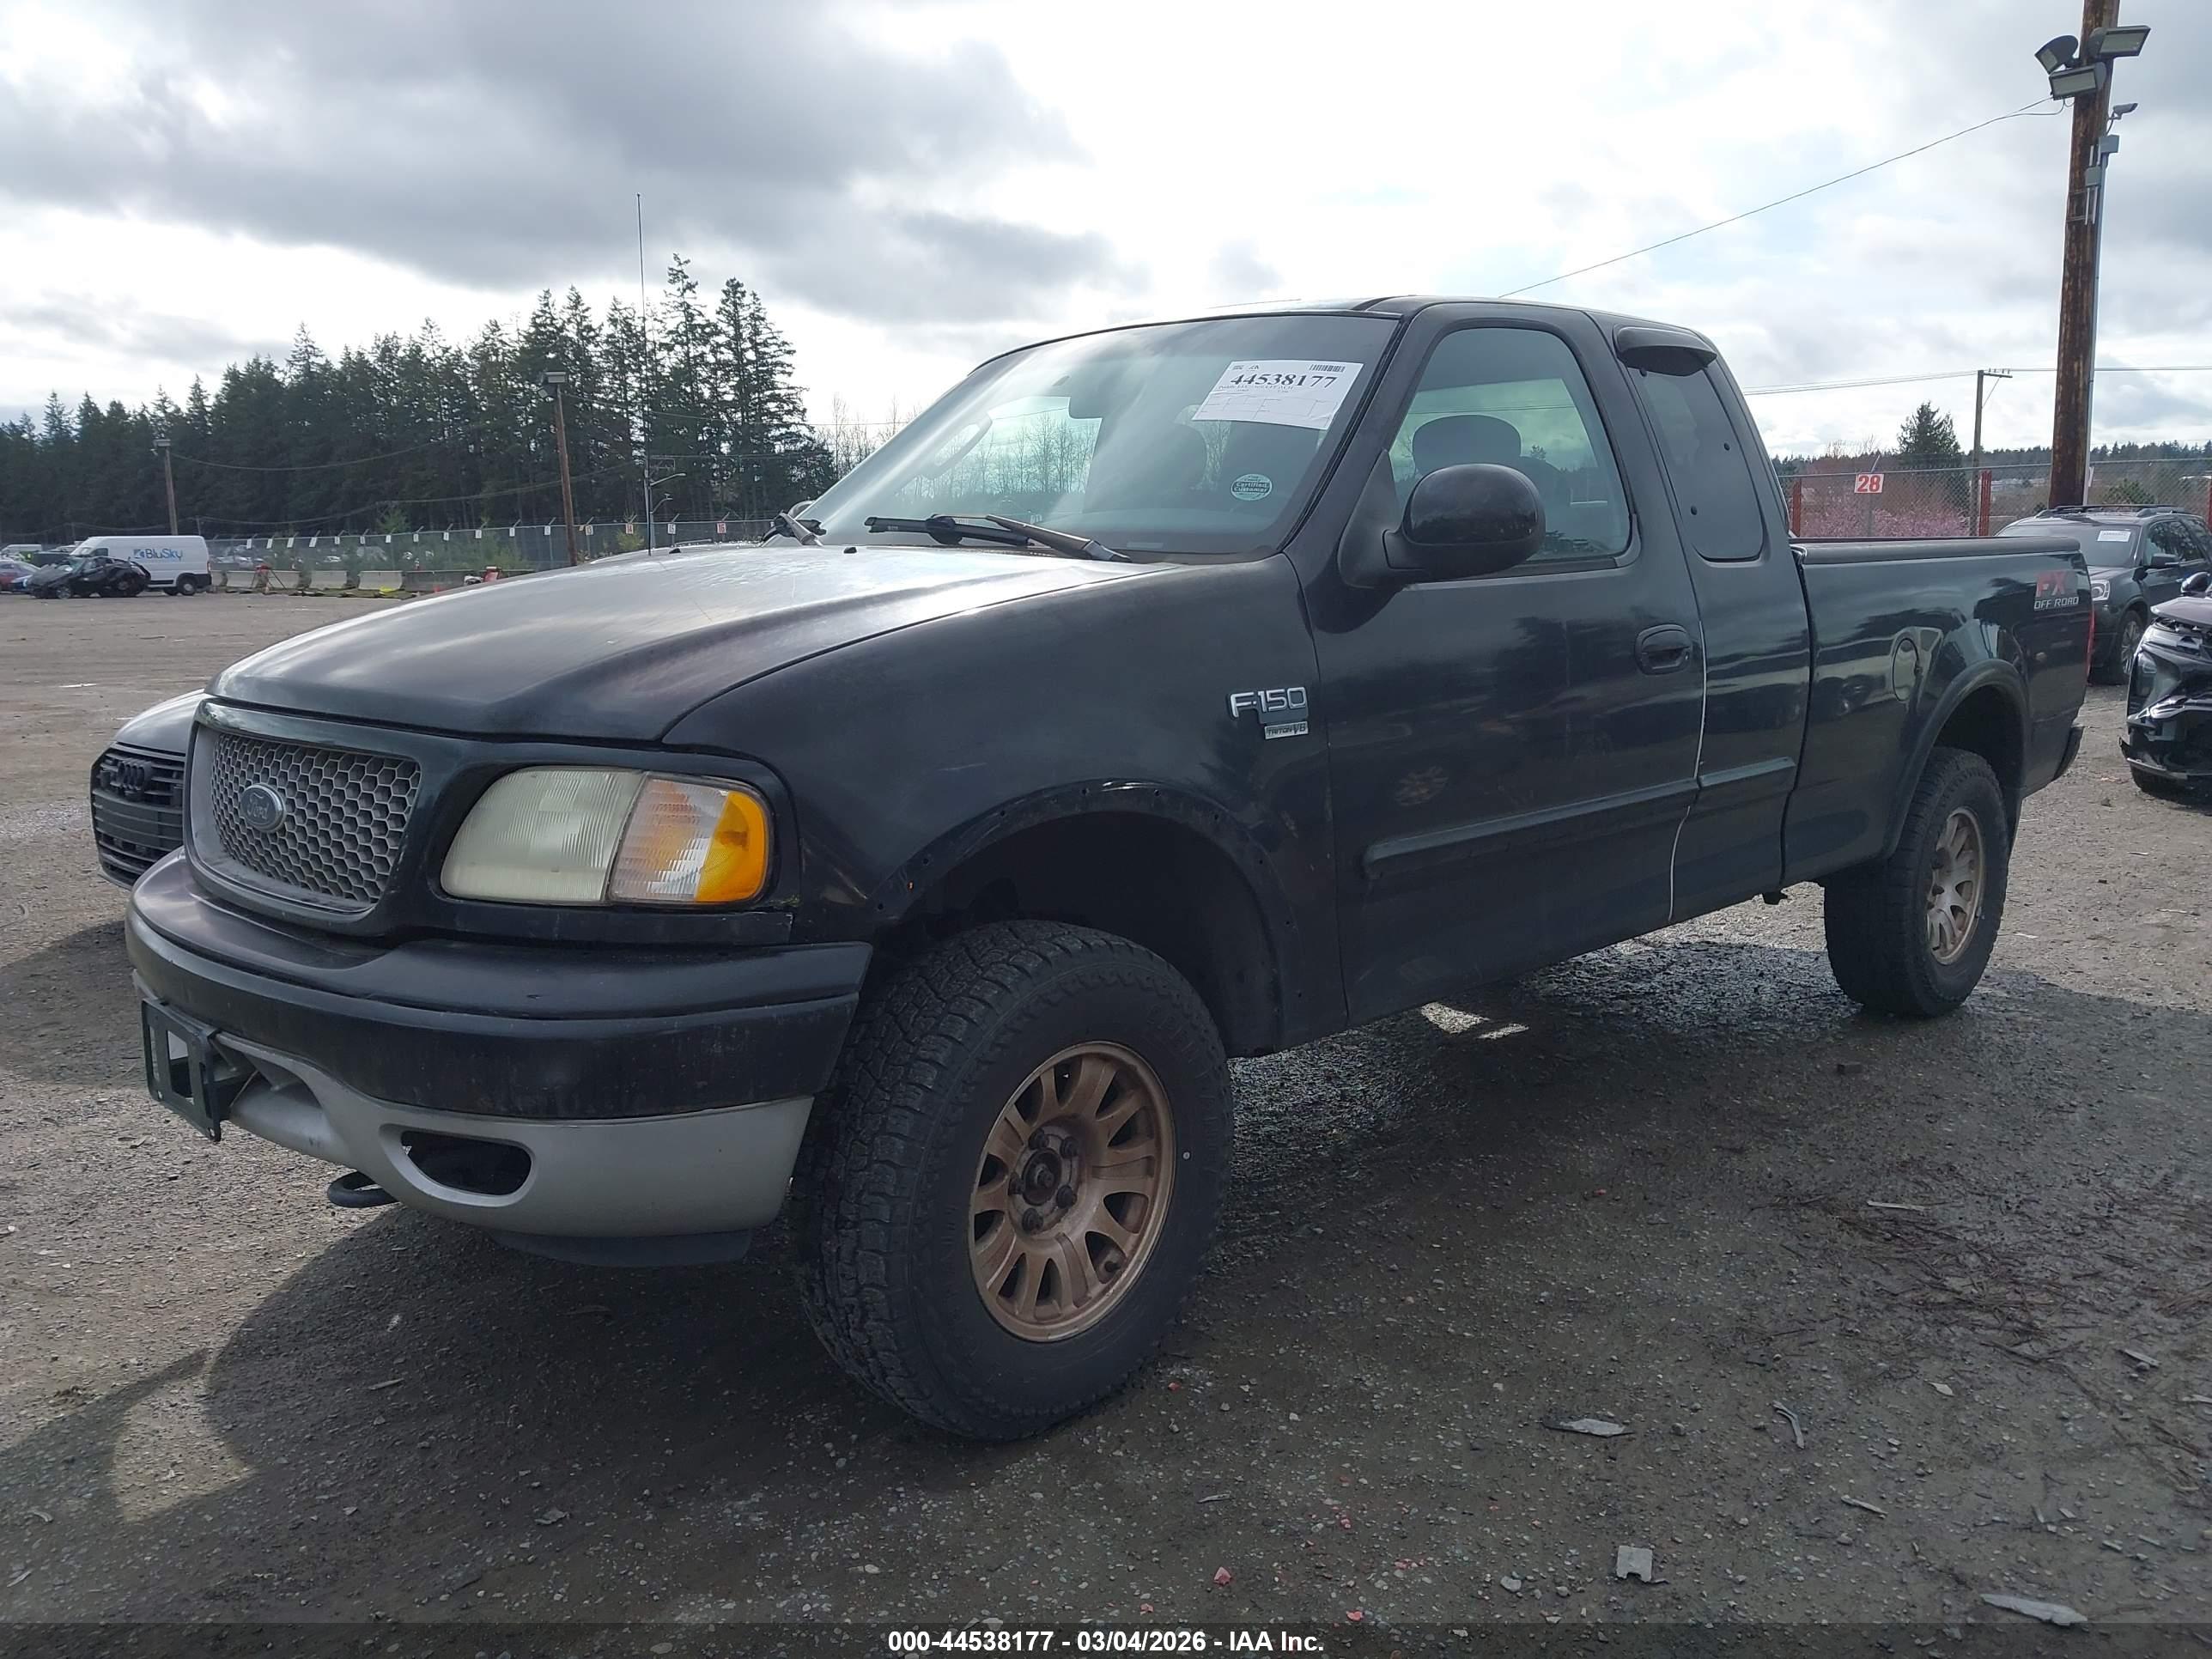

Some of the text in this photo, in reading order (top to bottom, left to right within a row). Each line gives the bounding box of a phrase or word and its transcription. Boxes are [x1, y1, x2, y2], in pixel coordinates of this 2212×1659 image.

[1230, 373, 1337, 389] 44538177
[1857, 475, 1881, 492] 28
[145, 548, 183, 562] BluSky
[2033, 596, 2080, 610] OFF ROAD
[246, 792, 270, 820] Ford
